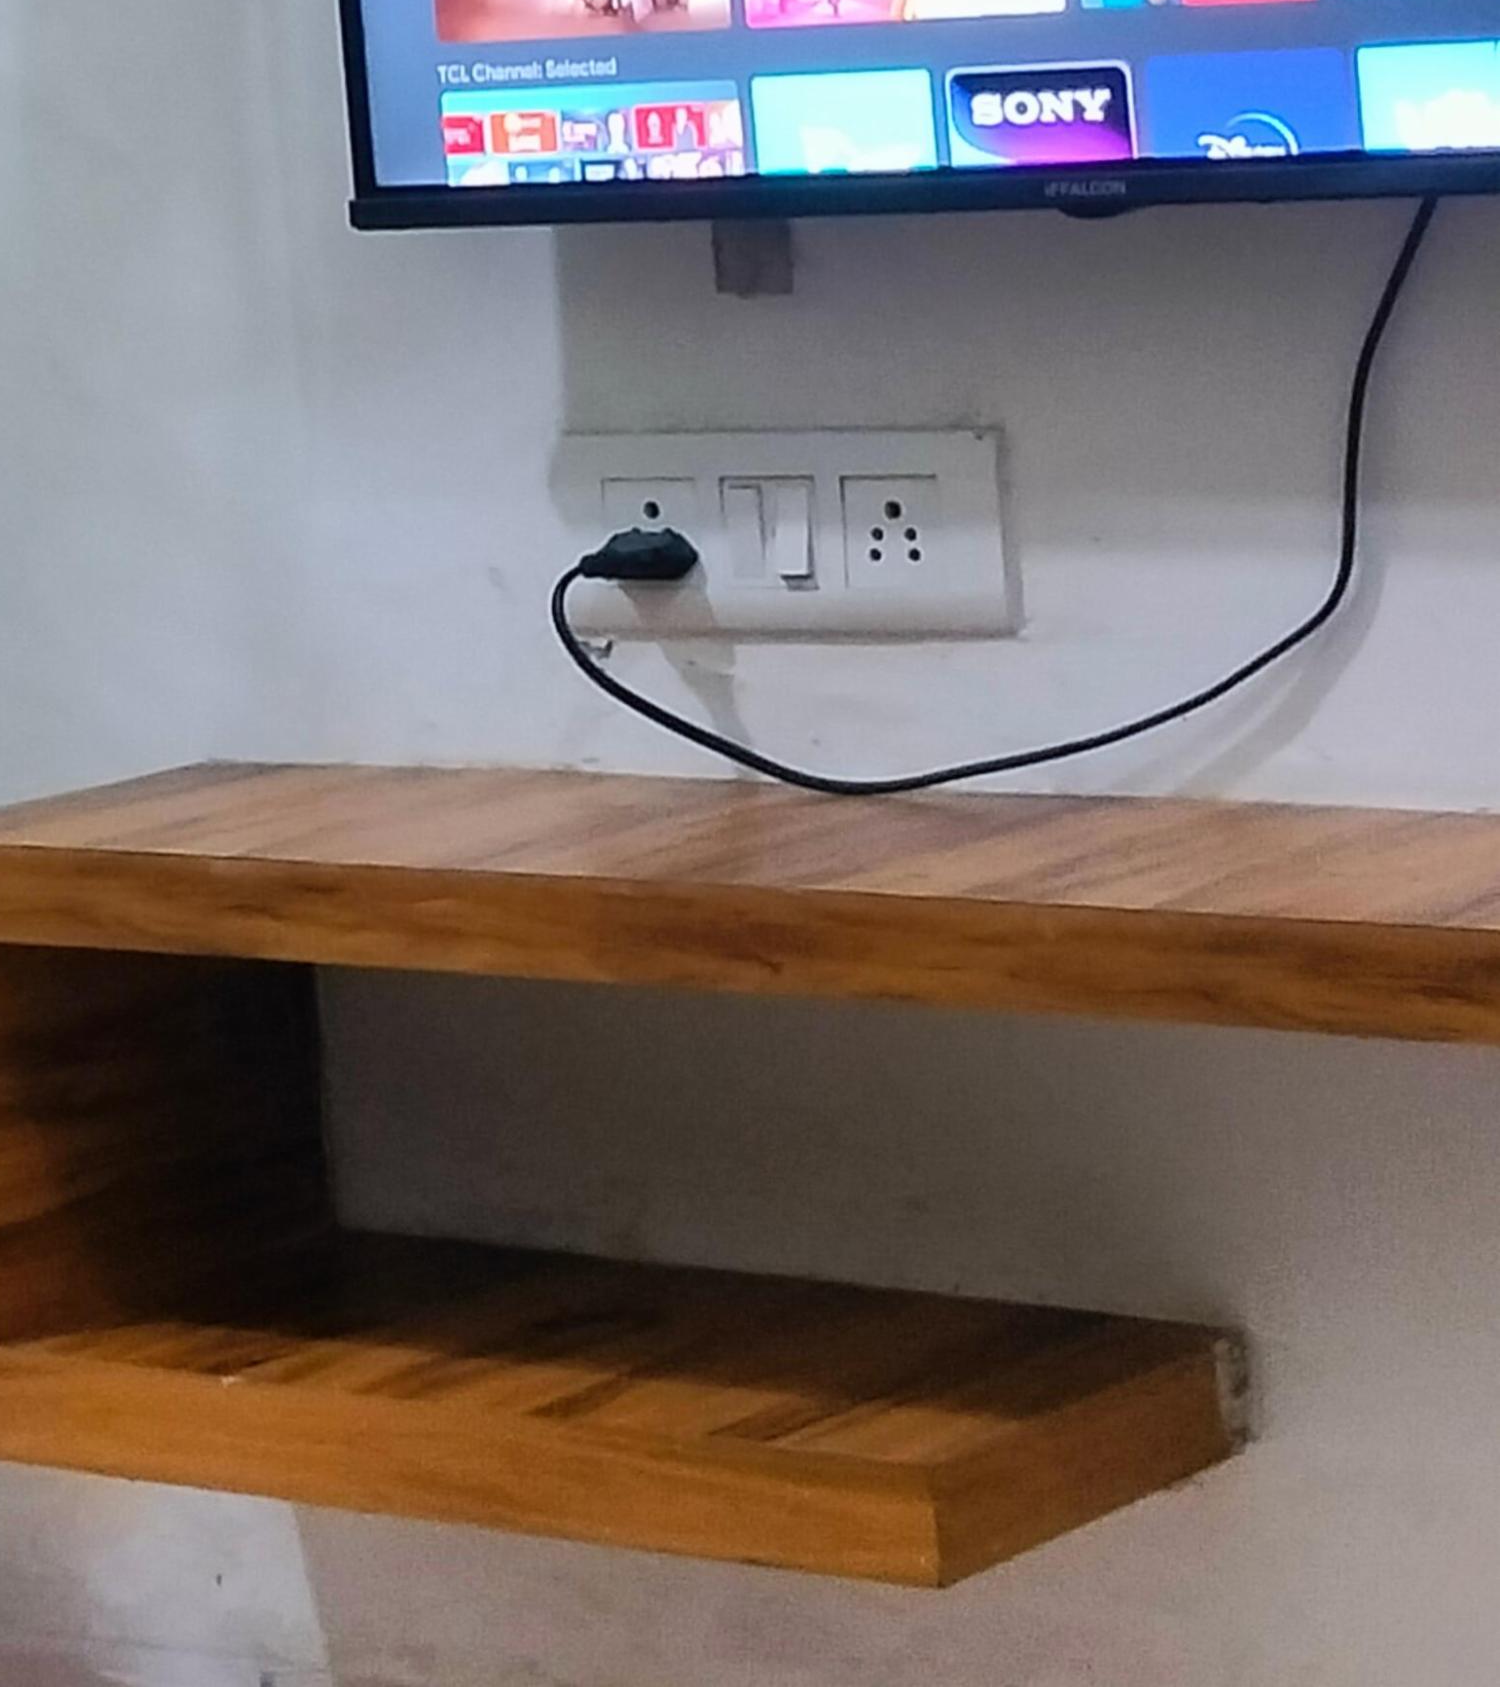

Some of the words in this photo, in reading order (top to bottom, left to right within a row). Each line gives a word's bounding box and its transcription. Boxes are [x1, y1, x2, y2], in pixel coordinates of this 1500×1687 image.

[436, 64, 470, 84] TCL
[545, 56, 618, 80] Selected
[970, 87, 1112, 127] SONY
